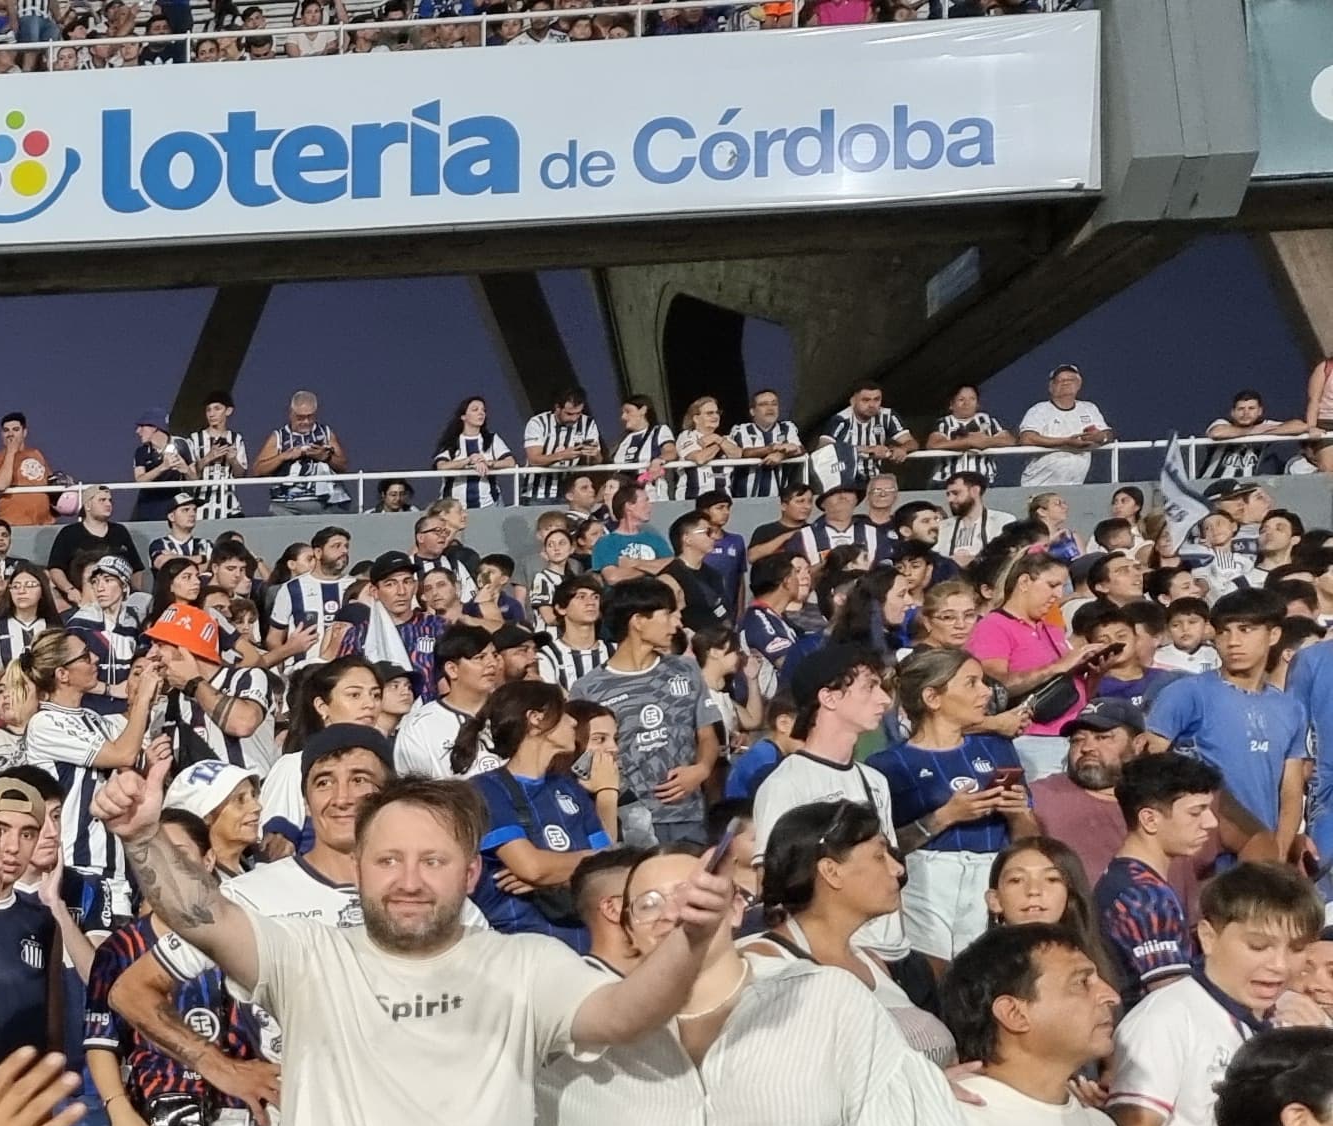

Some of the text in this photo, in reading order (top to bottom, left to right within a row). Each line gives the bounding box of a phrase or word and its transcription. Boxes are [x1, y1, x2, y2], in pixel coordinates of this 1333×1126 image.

[102, 99, 996, 213] lotería de Córdoba
